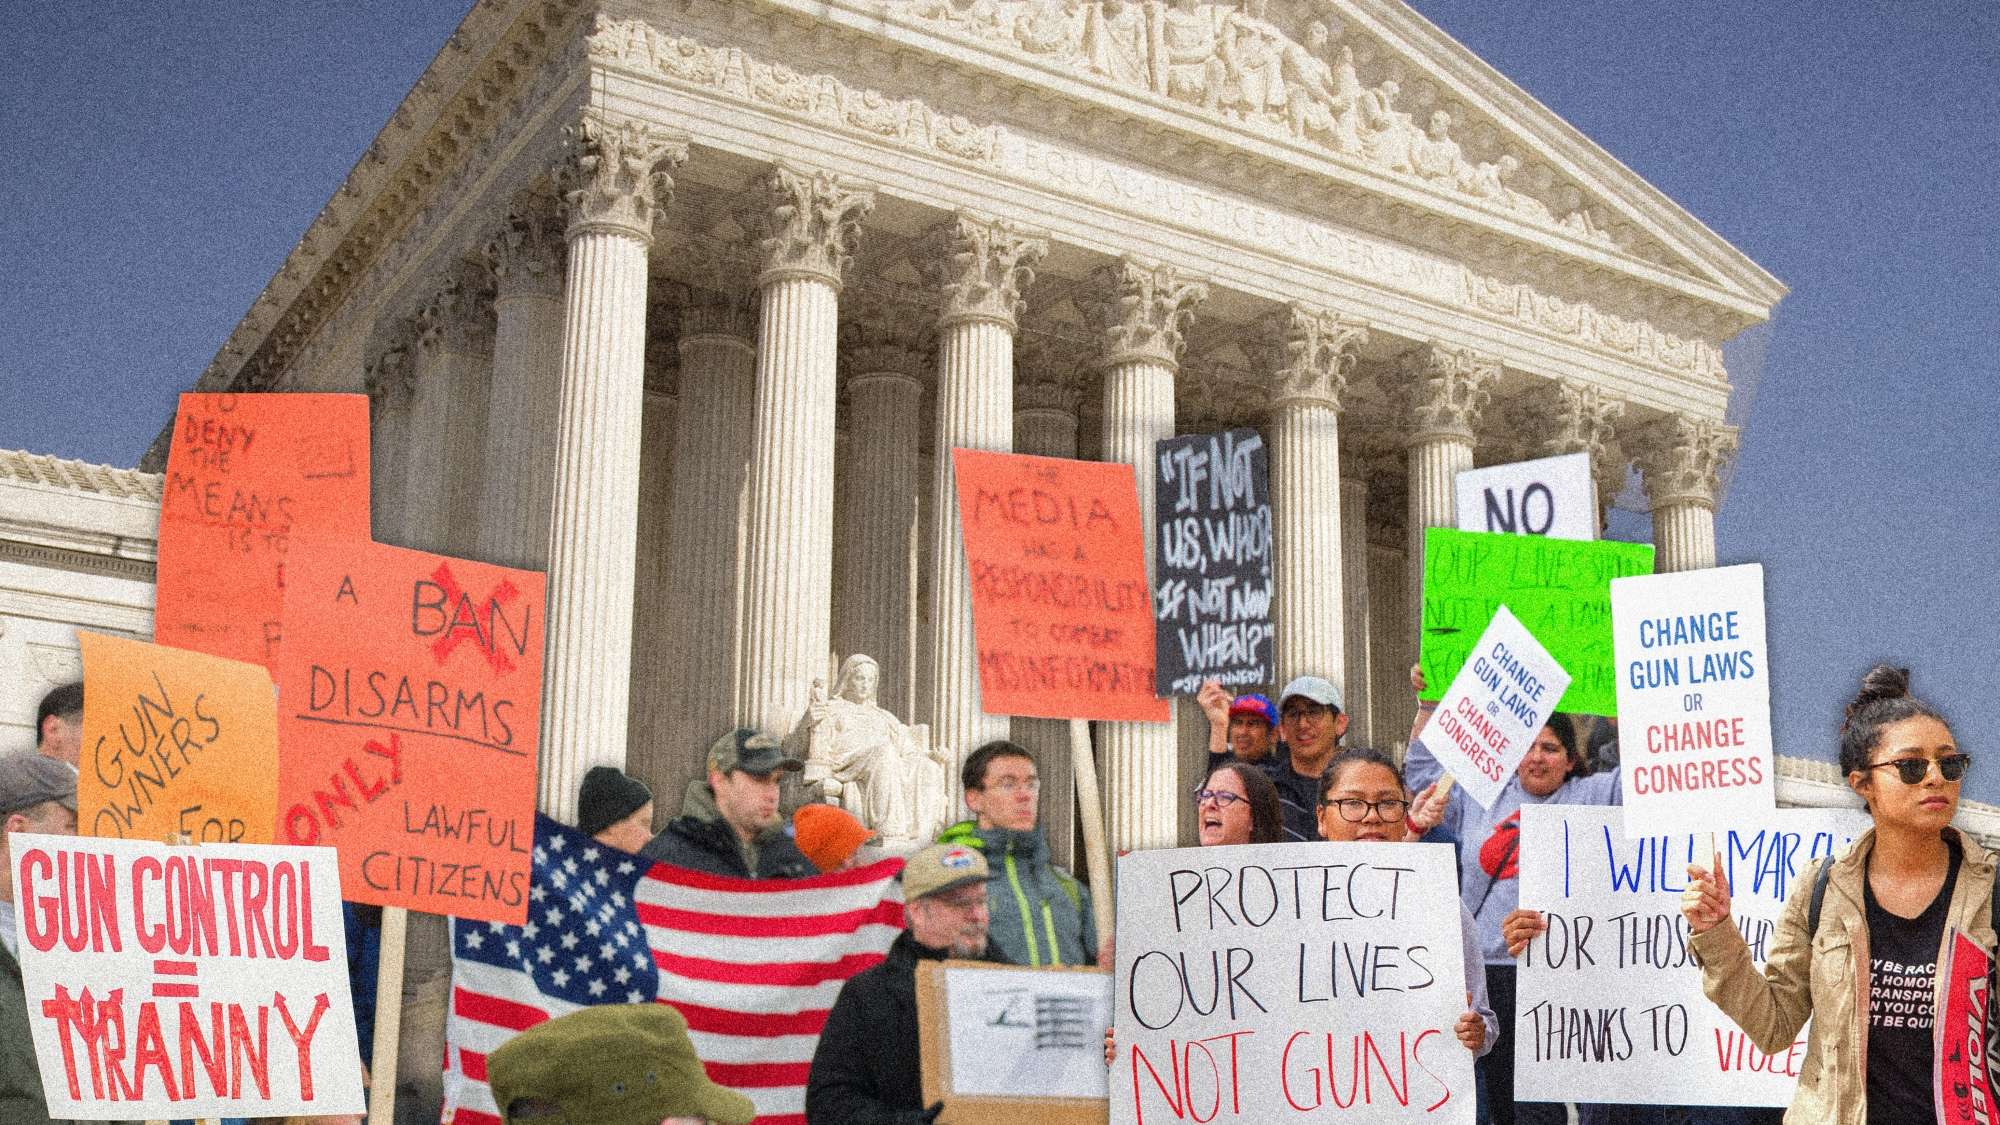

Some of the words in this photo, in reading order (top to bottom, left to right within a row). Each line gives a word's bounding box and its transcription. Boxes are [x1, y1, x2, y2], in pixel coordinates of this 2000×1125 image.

[184, 414, 256, 450] DENY
[168, 472, 294, 522] MEANS
[1210, 432, 1263, 511] NOT
[973, 487, 1120, 532] MEDIA
[1484, 482, 1555, 535] NO
[336, 575, 358, 605] A
[412, 580, 532, 656] BAN
[1157, 578, 1188, 620] IF
[1187, 576, 1236, 625] NOT
[1426, 597, 1475, 628] NOT
[1640, 611, 1740, 649] CHANGE
[1473, 656, 1503, 692] GUN
[1498, 685, 1538, 729] LAWS
[1491, 643, 1546, 703] CHANGE
[1630, 657, 1680, 690] GUN
[1688, 650, 1755, 684] LAWS
[95, 670, 175, 789] GUN
[309, 664, 513, 746] DISARMS
[1457, 696, 1511, 756] CHANGE
[1486, 701, 1500, 718] OR
[1683, 693, 1703, 712] OR
[1438, 709, 1504, 783] CONGRESS
[1647, 717, 1745, 754] CHANGE
[95, 693, 220, 839] OWNERS
[284, 732, 402, 846] ONLY
[1633, 756, 1763, 795] CONGRESS
[179, 804, 246, 843] FOR
[403, 801, 528, 854] LAWFUL
[361, 851, 526, 907] CITIZENS
[1562, 820, 1570, 898] I
[19, 848, 122, 953] GUN
[131, 855, 330, 962] CONTROL
[1169, 862, 1415, 932] PROTECT
[1608, 911, 1698, 969] THOS
[1883, 961, 1903, 974] BE
[1905, 963, 1936, 975] RAC
[1129, 947, 1268, 1030] OUR
[1297, 940, 1435, 1003] LIVES
[1883, 1002, 1915, 1014] YOU
[41, 982, 331, 1101] TYRANNY
[1523, 1000, 1633, 1063] THANKS
[1640, 1003, 1689, 1057] TO
[1883, 1015, 1905, 1028] BE
[1131, 1030, 1255, 1125] NOT
[1281, 1029, 1451, 1113] GUNS
